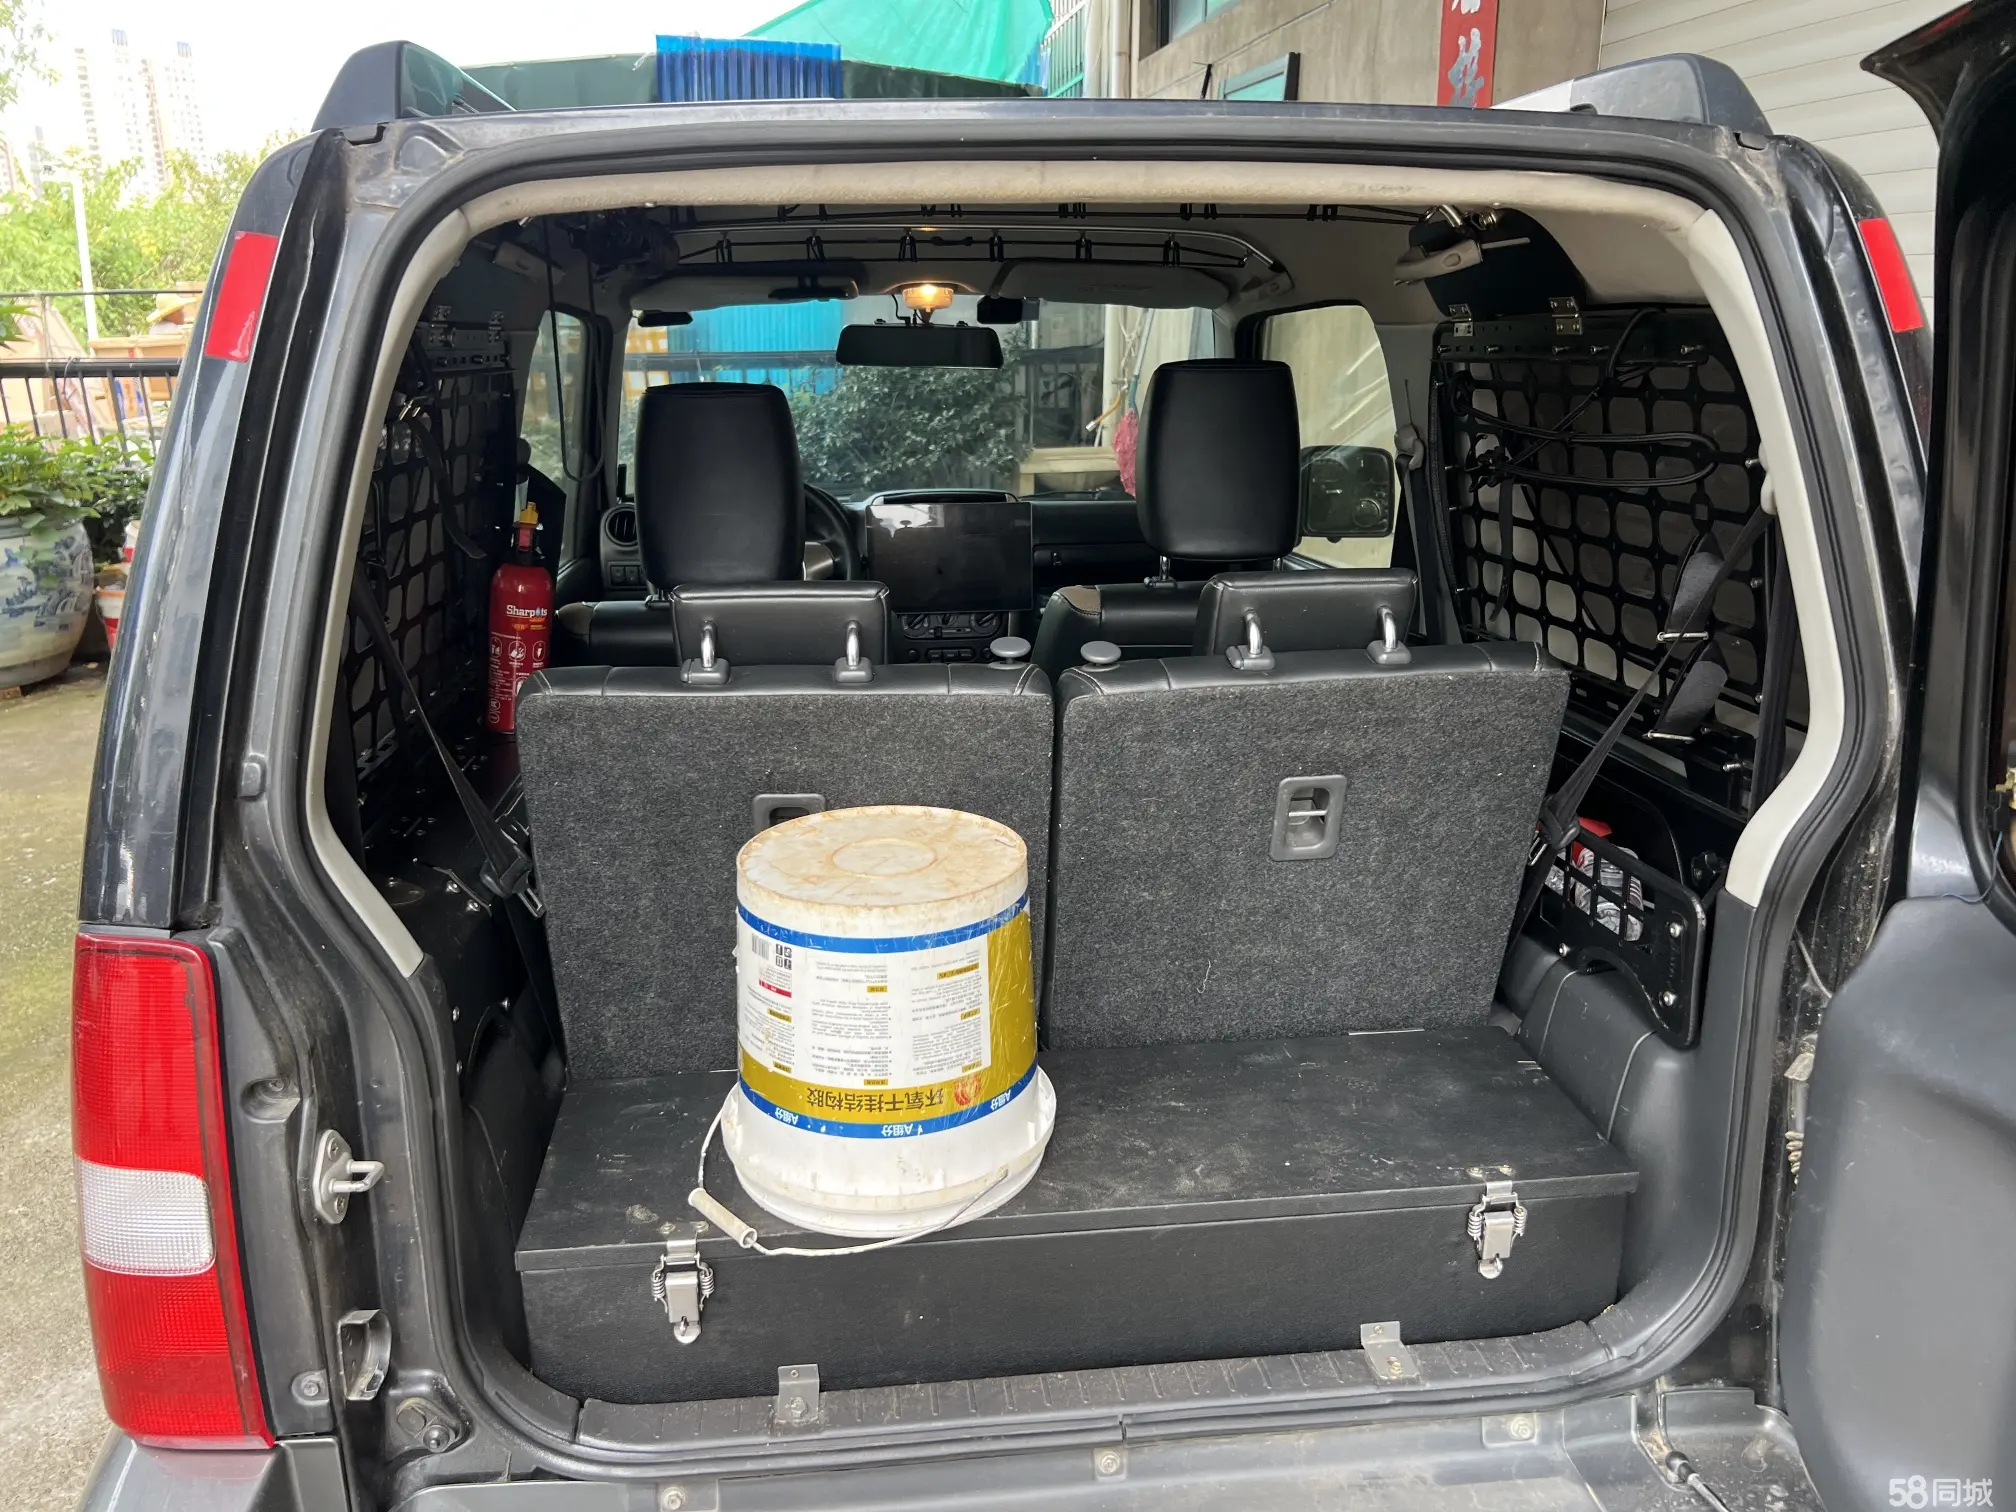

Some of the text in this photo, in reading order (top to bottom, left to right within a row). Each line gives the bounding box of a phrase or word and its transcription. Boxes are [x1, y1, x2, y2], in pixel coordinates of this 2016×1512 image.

[807, 1088, 944, 1112] 环氧干挂结构胶
[990, 1090, 1011, 1111] A组分
[774, 1107, 799, 1125] A组分
[881, 1123, 914, 1137] A组分
